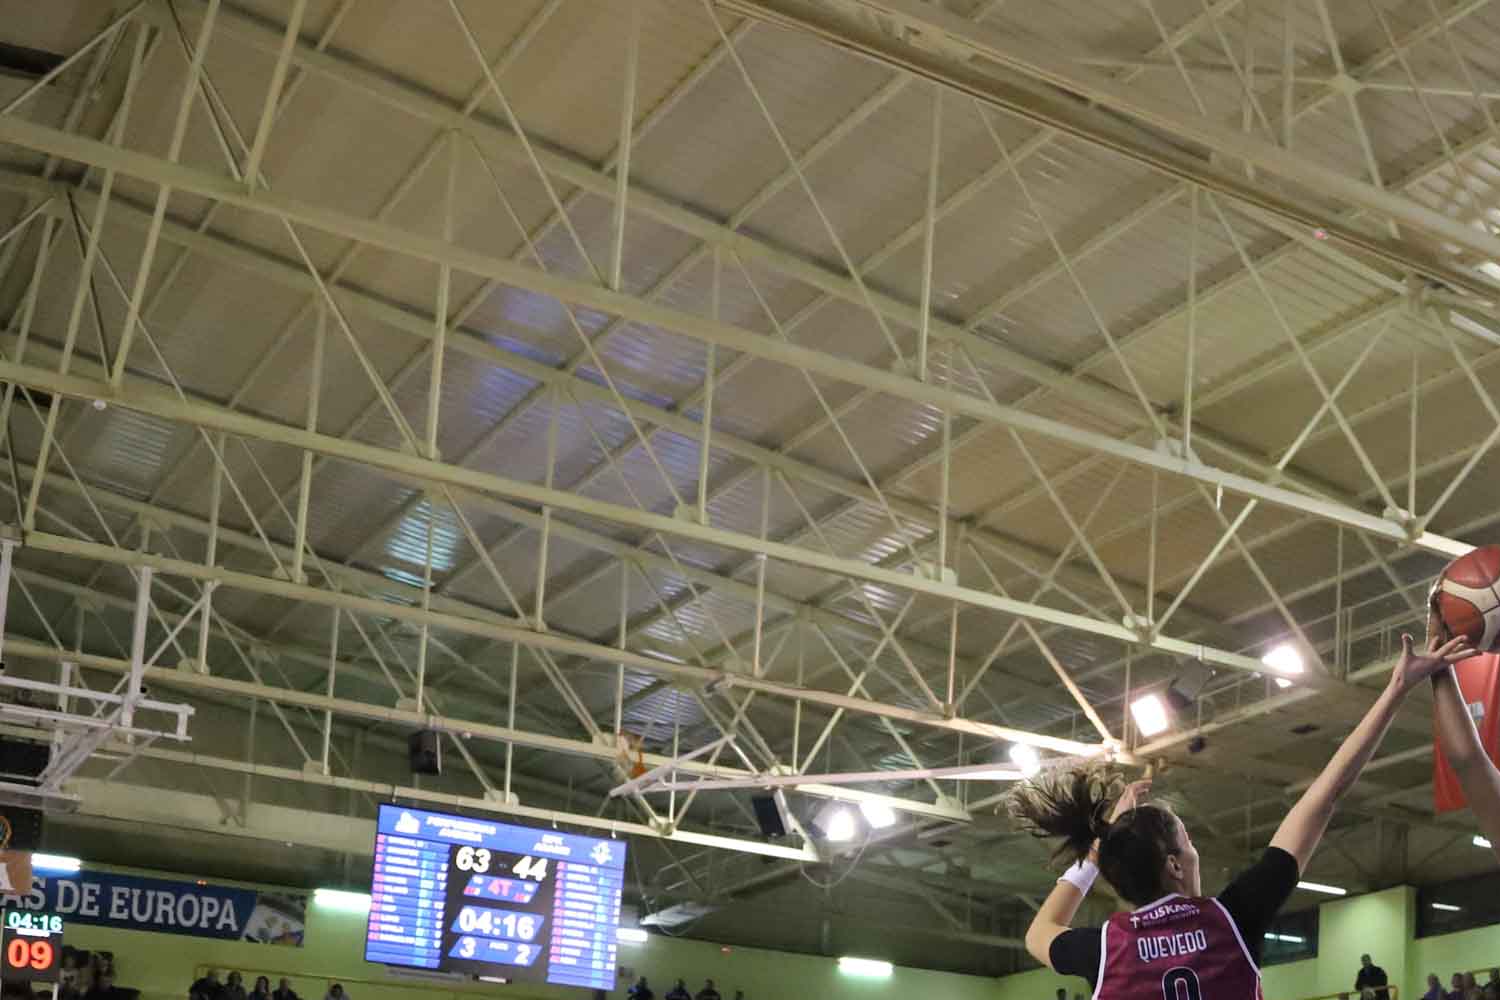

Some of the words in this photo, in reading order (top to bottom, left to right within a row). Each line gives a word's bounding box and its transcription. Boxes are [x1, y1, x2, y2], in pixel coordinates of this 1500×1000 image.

[456, 846, 492, 873] 63
[512, 856, 549, 882] 44
[8, 911, 63, 932] 04:16
[55, 879, 101, 917] DE
[108, 885, 239, 932] EUROPA
[459, 908, 535, 941] 04:16
[7, 938, 54, 970] 09
[459, 937, 477, 958] 3
[514, 946, 531, 965] 2
[1137, 929, 1208, 963] QUEVEDO
